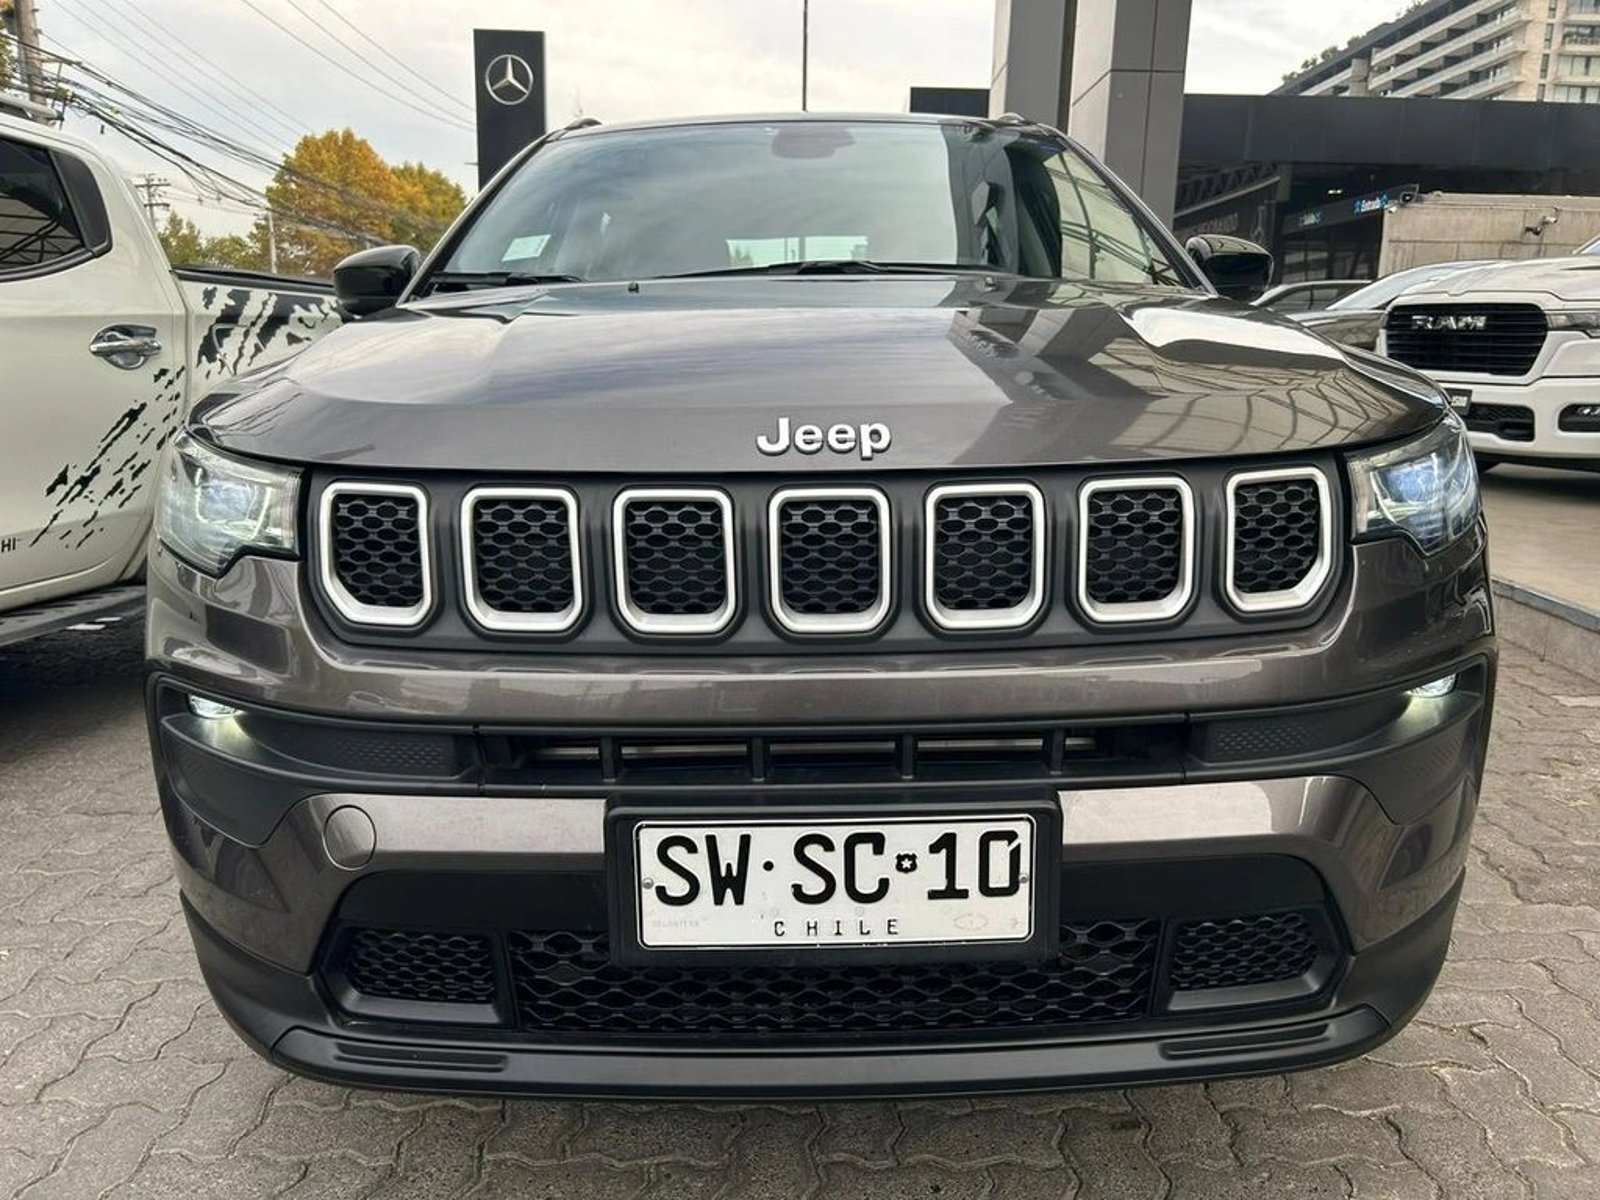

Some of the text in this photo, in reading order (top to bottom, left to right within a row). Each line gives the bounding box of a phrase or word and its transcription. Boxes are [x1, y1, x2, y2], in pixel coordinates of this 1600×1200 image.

[1412, 315, 1487, 330] RAM
[757, 417, 891, 460] Jeep
[774, 919, 899, 938] CHILE
